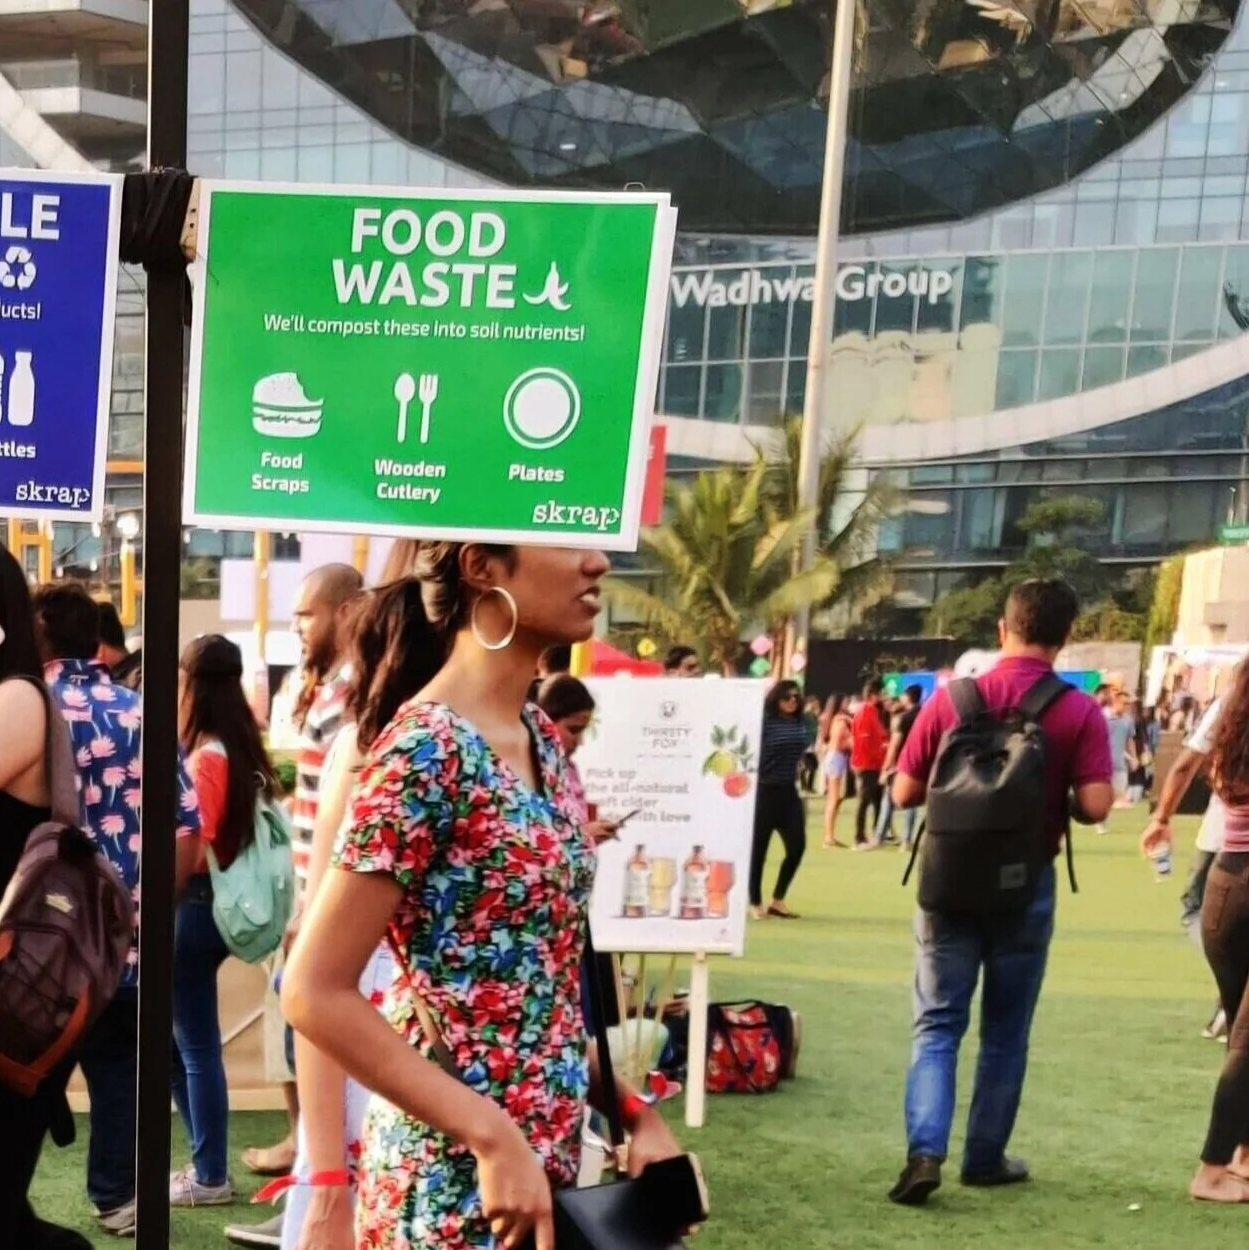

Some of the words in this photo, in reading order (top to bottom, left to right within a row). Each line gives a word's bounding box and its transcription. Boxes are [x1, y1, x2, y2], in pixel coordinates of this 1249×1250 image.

[351, 208, 506, 257] FOOD
[332, 259, 517, 309] WASTE
[671, 269, 817, 308] Wadhwa
[835, 266, 952, 305] Group
[264, 314, 304, 332] We'll
[308, 319, 380, 338] compost
[384, 320, 430, 337] these
[433, 323, 466, 338] into
[470, 323, 500, 339] soil
[503, 325, 585, 342] nutrients!
[260, 452, 303, 470] Food
[374, 458, 446, 478] Wooden
[509, 463, 565, 482] Plates
[16, 480, 90, 508] skrap
[252, 474, 309, 495] Scraps
[376, 482, 441, 504] Cutlery
[532, 500, 620, 531] skrap
[661, 810, 691, 822] love
